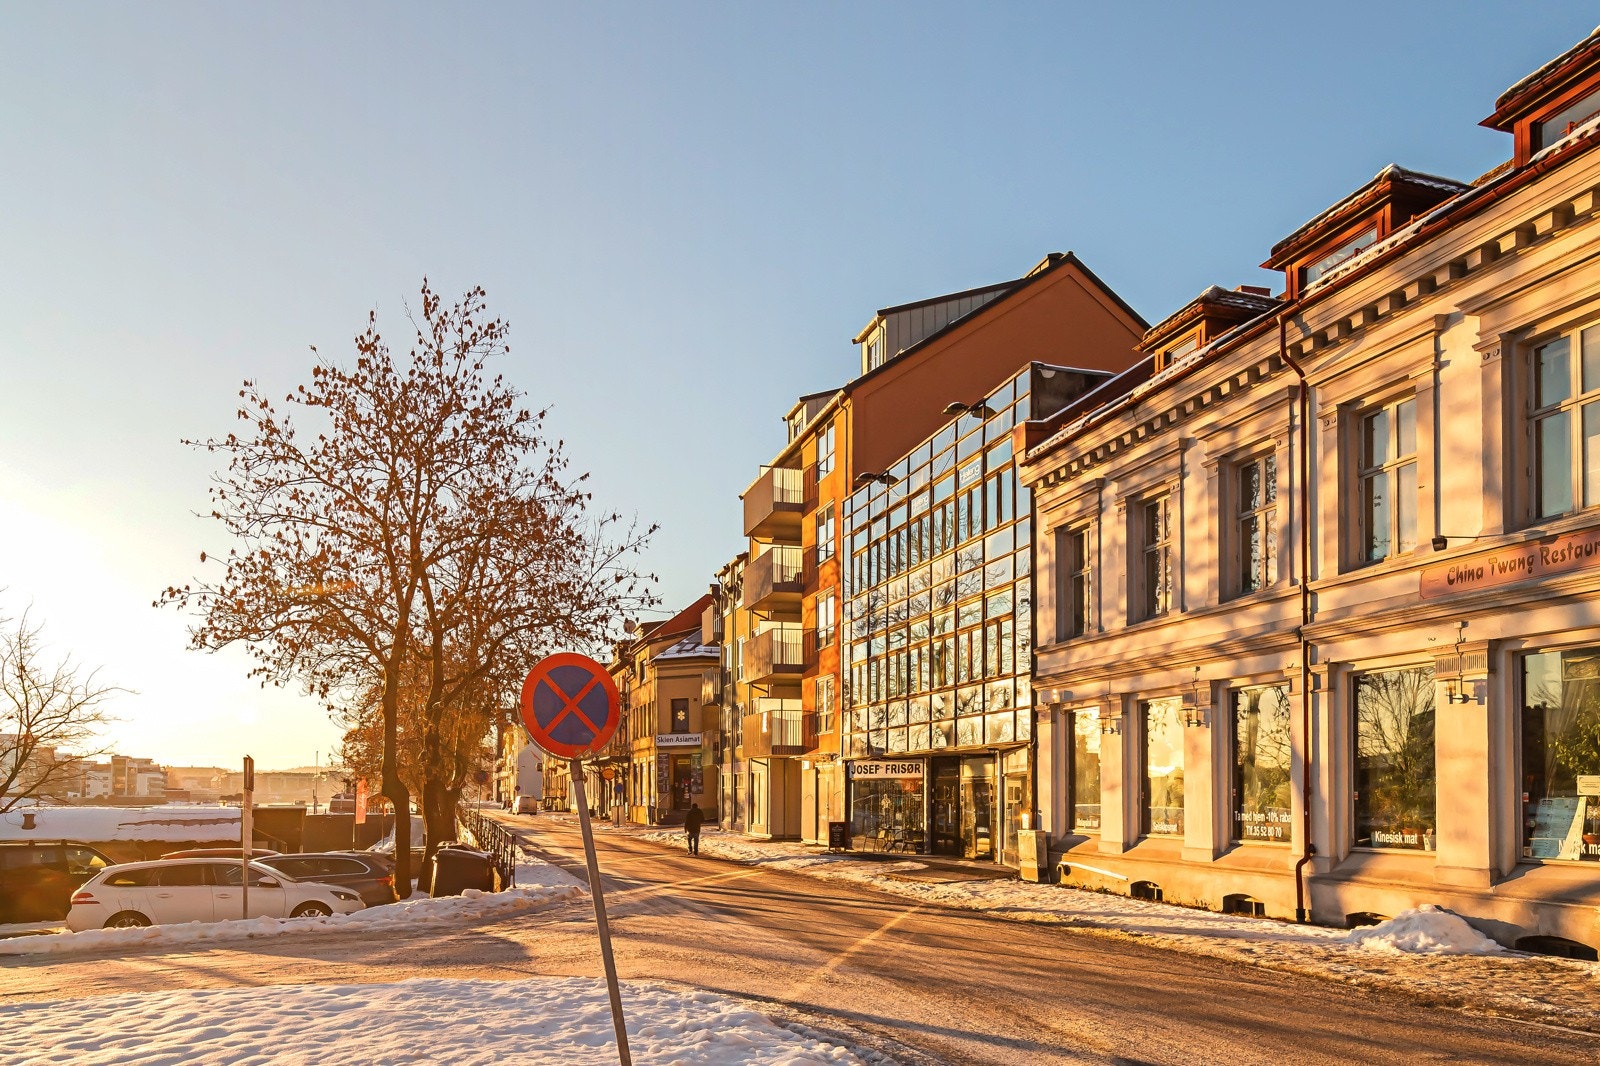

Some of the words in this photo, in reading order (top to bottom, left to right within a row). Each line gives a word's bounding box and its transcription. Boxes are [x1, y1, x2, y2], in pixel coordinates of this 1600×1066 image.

[1446, 564, 1484, 586] China
[1488, 554, 1535, 575] Twang
[1539, 541, 1600, 566] Restaur
[851, 764, 880, 775] JOSEF
[885, 763, 921, 774] FRISØR
[1234, 810, 1241, 821] Ta
[1241, 811, 1252, 821] med
[1375, 831, 1403, 844] Kinesisk
[1404, 833, 1418, 844] mat
